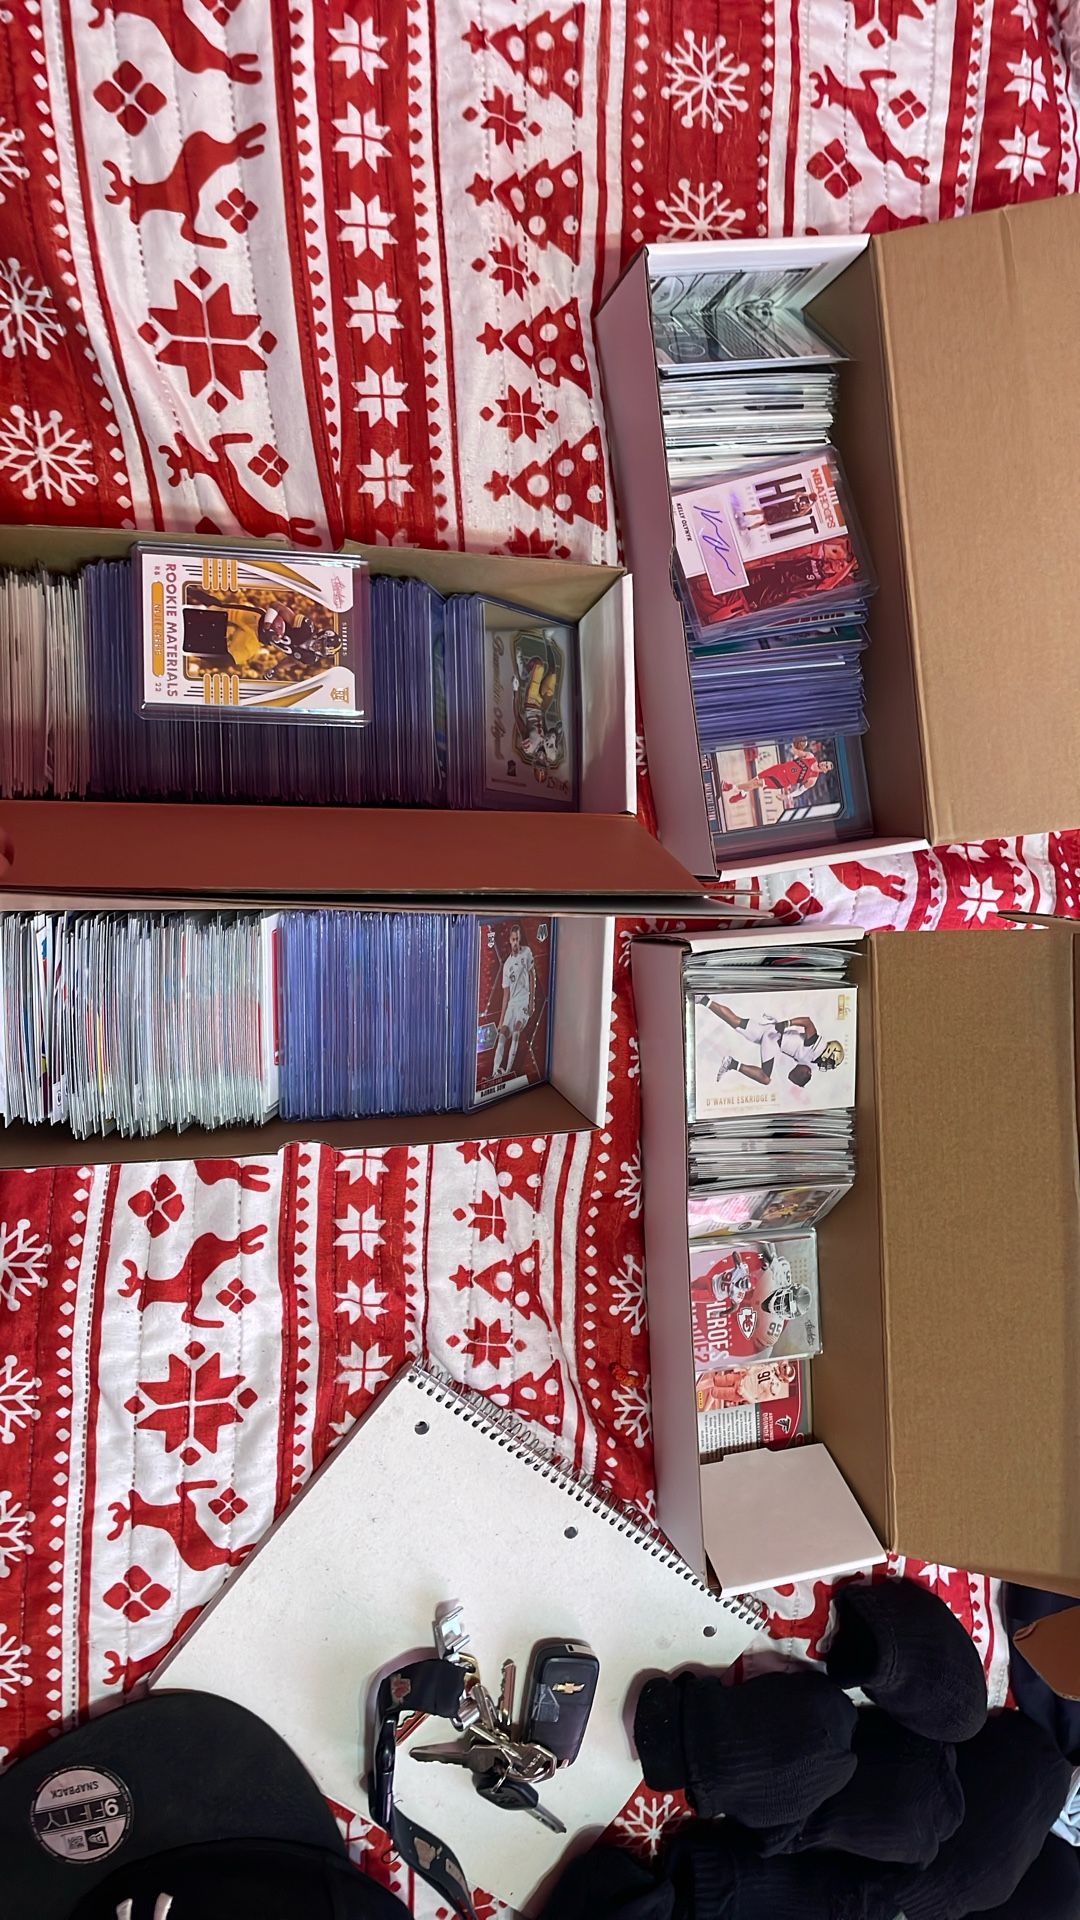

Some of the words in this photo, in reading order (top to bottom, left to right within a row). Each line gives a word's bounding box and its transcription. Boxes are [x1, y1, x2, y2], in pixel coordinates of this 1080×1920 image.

[811, 468, 826, 495] NBA
[676, 502, 685, 519] KELLY
[681, 519, 693, 543] OLYNYK
[165, 563, 178, 617] ROOKIE
[805, 573, 815, 582] 9
[166, 622, 179, 697] MATERIALS
[706, 1096, 735, 1107] D'WAYNE
[737, 1094, 769, 1105] ESKRIDGE
[721, 1272, 732, 1293] 95
[51, 1781, 99, 1798] SNAPBACK
[42, 1798, 119, 1830] 9FIFTY
